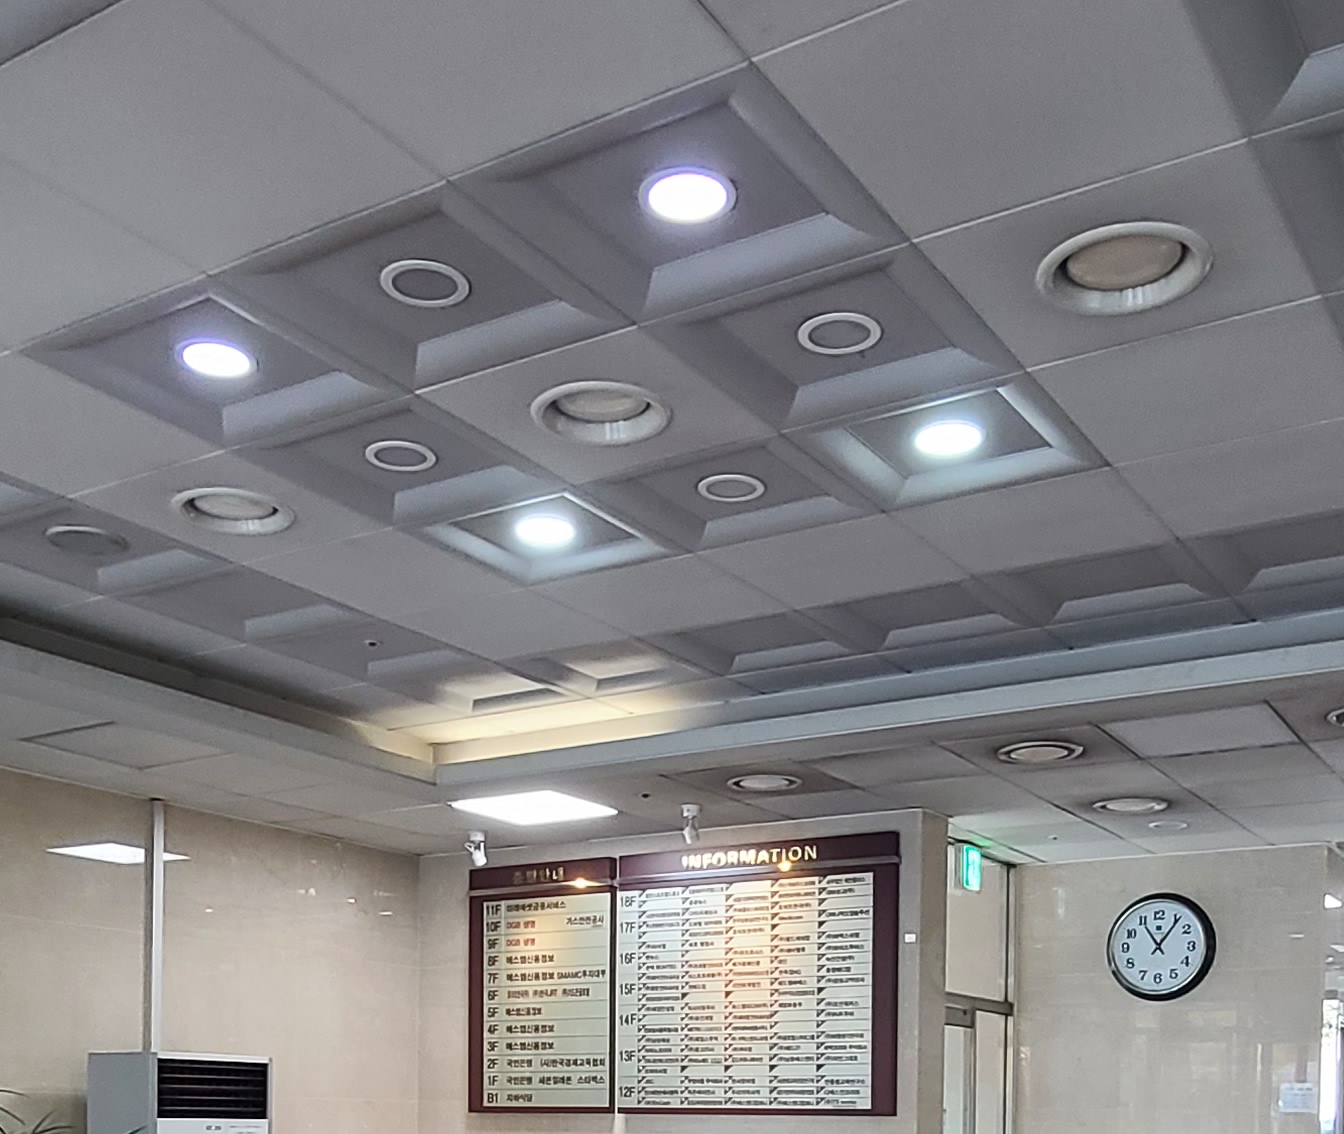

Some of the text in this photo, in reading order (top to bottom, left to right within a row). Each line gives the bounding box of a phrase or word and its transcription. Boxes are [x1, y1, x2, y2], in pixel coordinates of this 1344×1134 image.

[681, 845, 817, 869] INFORMATION
[619, 896, 636, 907] 18F
[486, 904, 501, 915] 11F
[1153, 910, 1166, 920] 12
[1139, 915, 1147, 926] 11
[486, 921, 501, 932] 10F
[619, 922, 636, 934] 17F
[1181, 924, 1192, 935] 2
[1126, 928, 1137, 939] 10
[487, 938, 499, 949] 9F
[1121, 942, 1130, 953] 9
[1187, 940, 1196, 952] 3
[488, 956, 499, 967] 8F
[619, 953, 636, 964] 16F
[1126, 958, 1135, 969] 8
[1180, 955, 1190, 967] 4
[488, 973, 499, 984] 7F
[1138, 970, 1148, 981] 7
[1153, 973, 1163, 984] 6
[1169, 968, 1178, 979] 5
[619, 983, 636, 995] 15F
[487, 990, 499, 1001] 6F
[487, 1007, 499, 1018] 5F
[619, 1013, 636, 1026] 14F
[488, 1025, 499, 1035] 4F
[487, 1041, 499, 1052] 3F
[619, 1050, 636, 1062] 13F
[487, 1058, 499, 1069] 2F
[488, 1075, 499, 1086] 1F
[619, 1086, 636, 1097] 12F
[487, 1092, 498, 1103] B1
